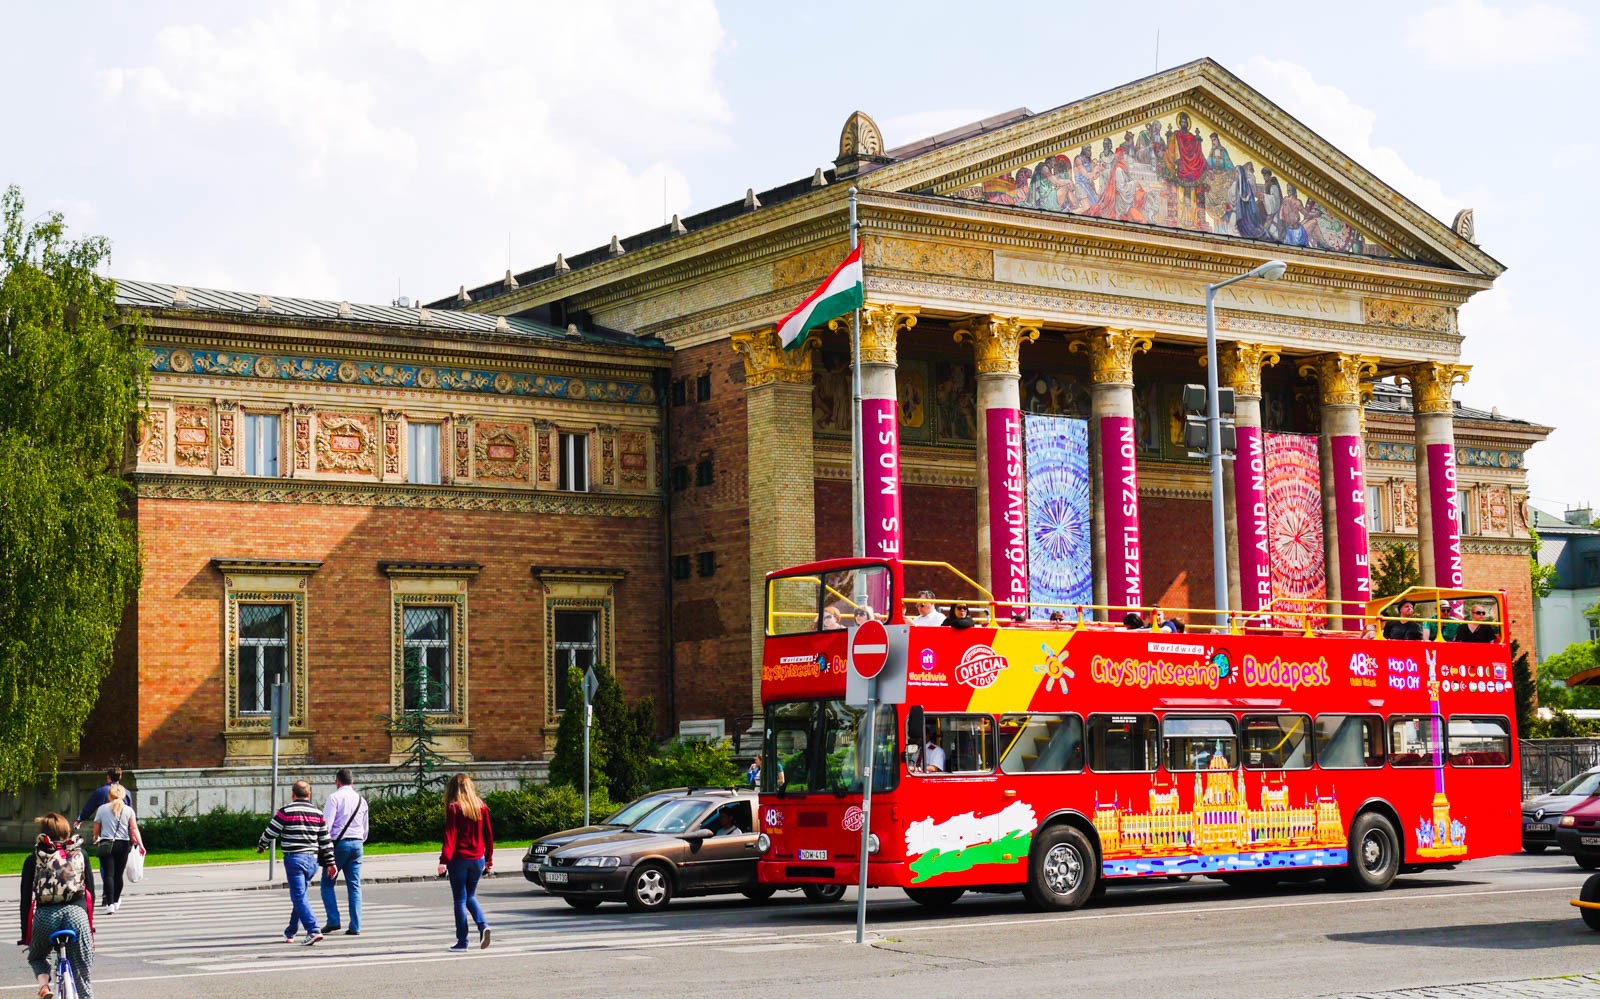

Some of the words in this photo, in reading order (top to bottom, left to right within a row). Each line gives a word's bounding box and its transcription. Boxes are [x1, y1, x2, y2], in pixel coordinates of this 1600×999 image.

[1037, 263, 1100, 285] MAGYAR
[877, 409, 898, 495] MOST
[1249, 436, 1265, 491] NOW
[1120, 426, 1138, 517] SZALON
[1349, 444, 1366, 528] ARTS
[1444, 452, 1459, 521] SALON
[877, 516, 899, 553] ÉS
[1253, 502, 1269, 553] AND
[1124, 525, 1141, 617] EMZETI
[1257, 564, 1272, 628] HERE
[1152, 643, 1203, 654] Worldwide
[1349, 653, 1366, 676] 48
[1388, 657, 1405, 673] Hop
[1406, 658, 1418, 672] On
[960, 657, 1007, 680] OFFICIAL
[975, 673, 996, 686] TOUR
[1091, 654, 1220, 690] CitySightseeing
[1243, 654, 1331, 691] Budapest
[1389, 675, 1406, 690] Hop
[1407, 675, 1420, 689] Off
